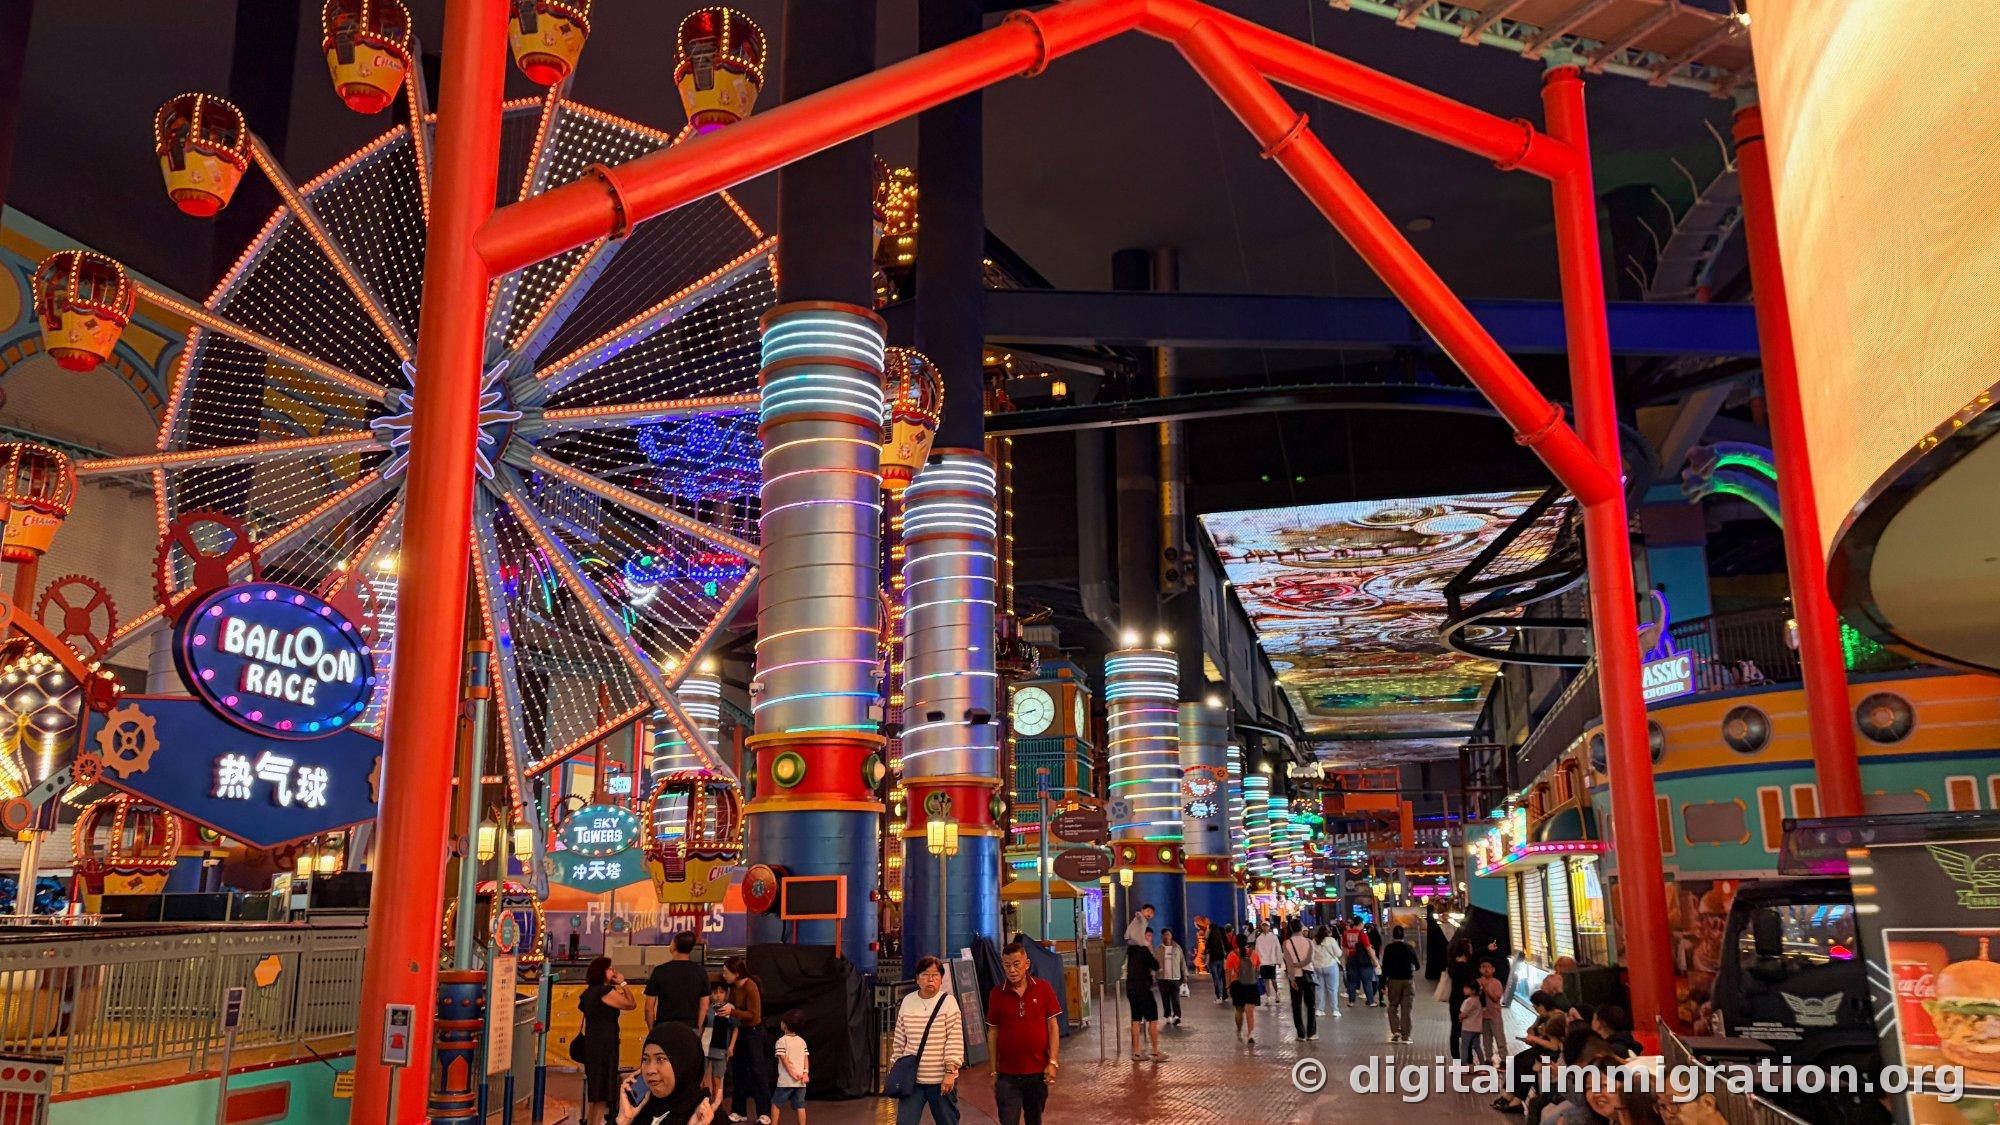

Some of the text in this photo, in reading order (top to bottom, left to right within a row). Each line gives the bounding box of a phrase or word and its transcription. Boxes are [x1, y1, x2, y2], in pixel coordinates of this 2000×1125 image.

[222, 617, 357, 684] BALLOON
[245, 663, 318, 706] RACE
[1642, 656, 1691, 688] ASSIC
[216, 751, 329, 808] 热气球
[573, 826, 623, 844] TOWERS
[593, 817, 620, 829] SKY
[572, 860, 622, 881] 冲天塔
